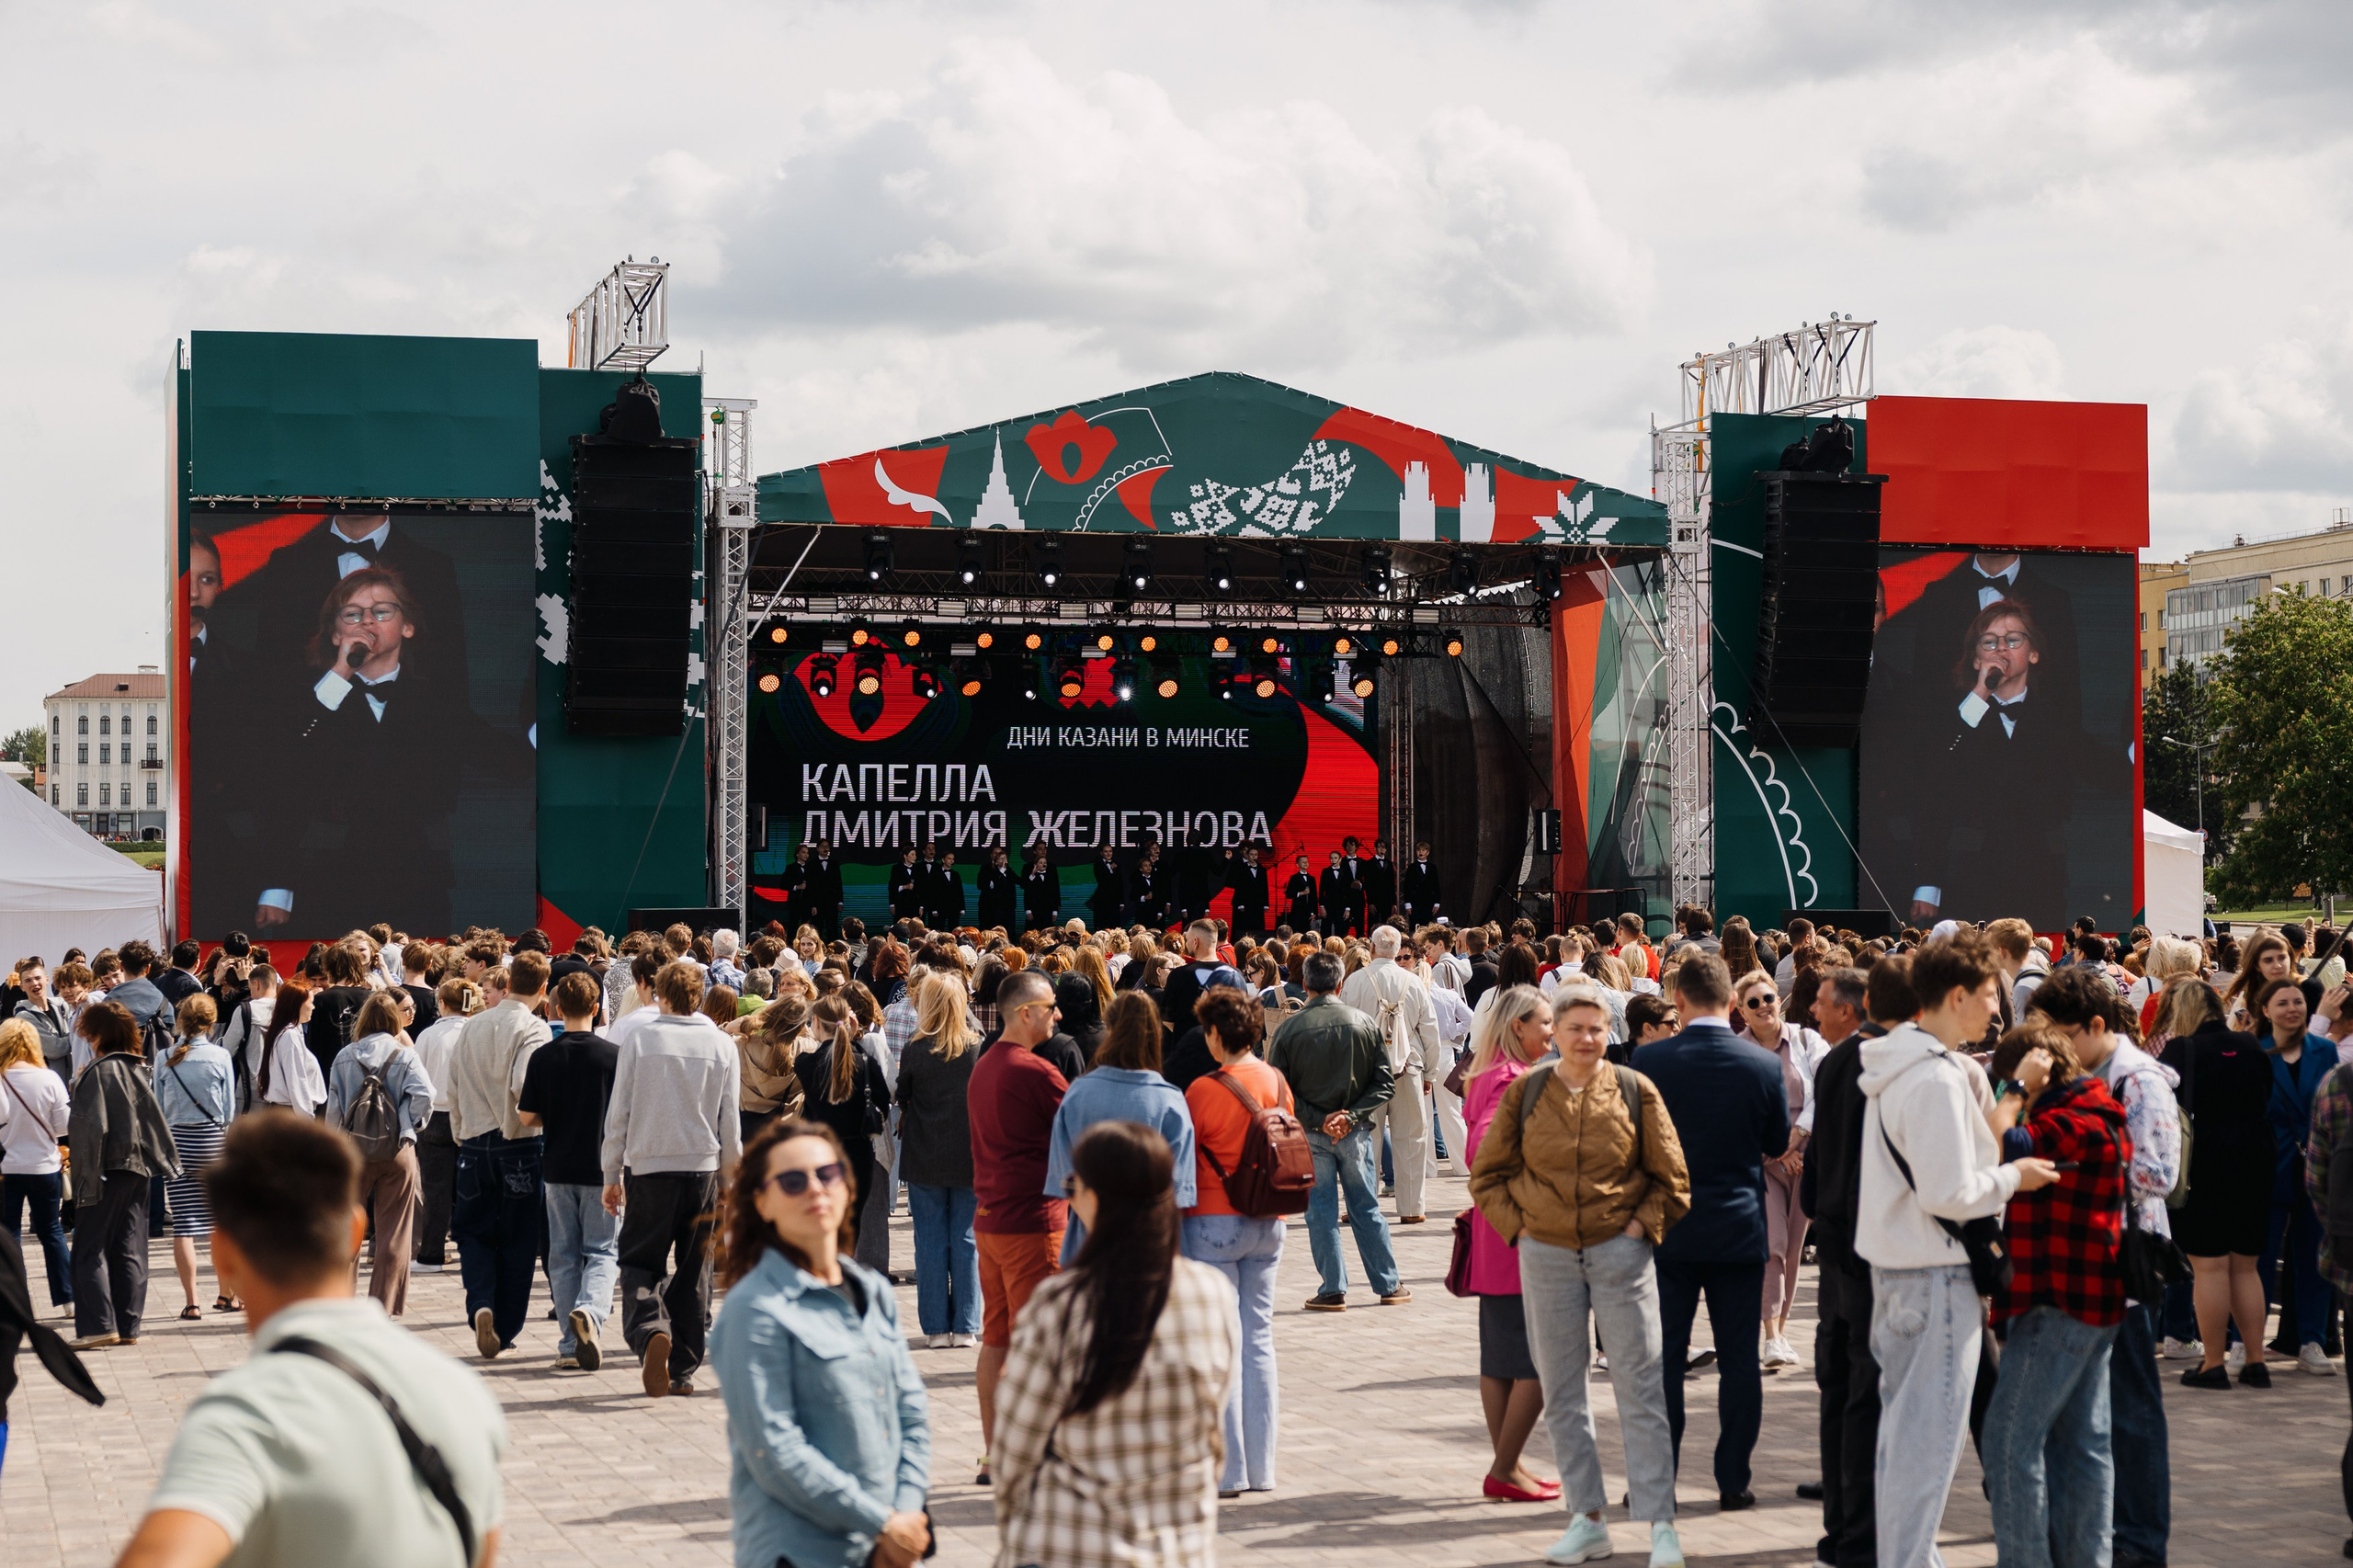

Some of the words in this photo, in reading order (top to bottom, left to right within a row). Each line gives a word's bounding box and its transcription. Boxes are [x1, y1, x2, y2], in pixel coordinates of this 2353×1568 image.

[1006, 726, 1051, 750] ДНИ
[1058, 726, 1138, 747] КАЗАНИ
[1146, 727, 1159, 747] В
[1165, 727, 1249, 748] МИНСКЕ
[802, 763, 996, 802] КАПЕЛЛА
[800, 810, 1006, 847] ДМИТРИЯ
[1022, 810, 1273, 847] ЖЕЛЕЗНОВА
